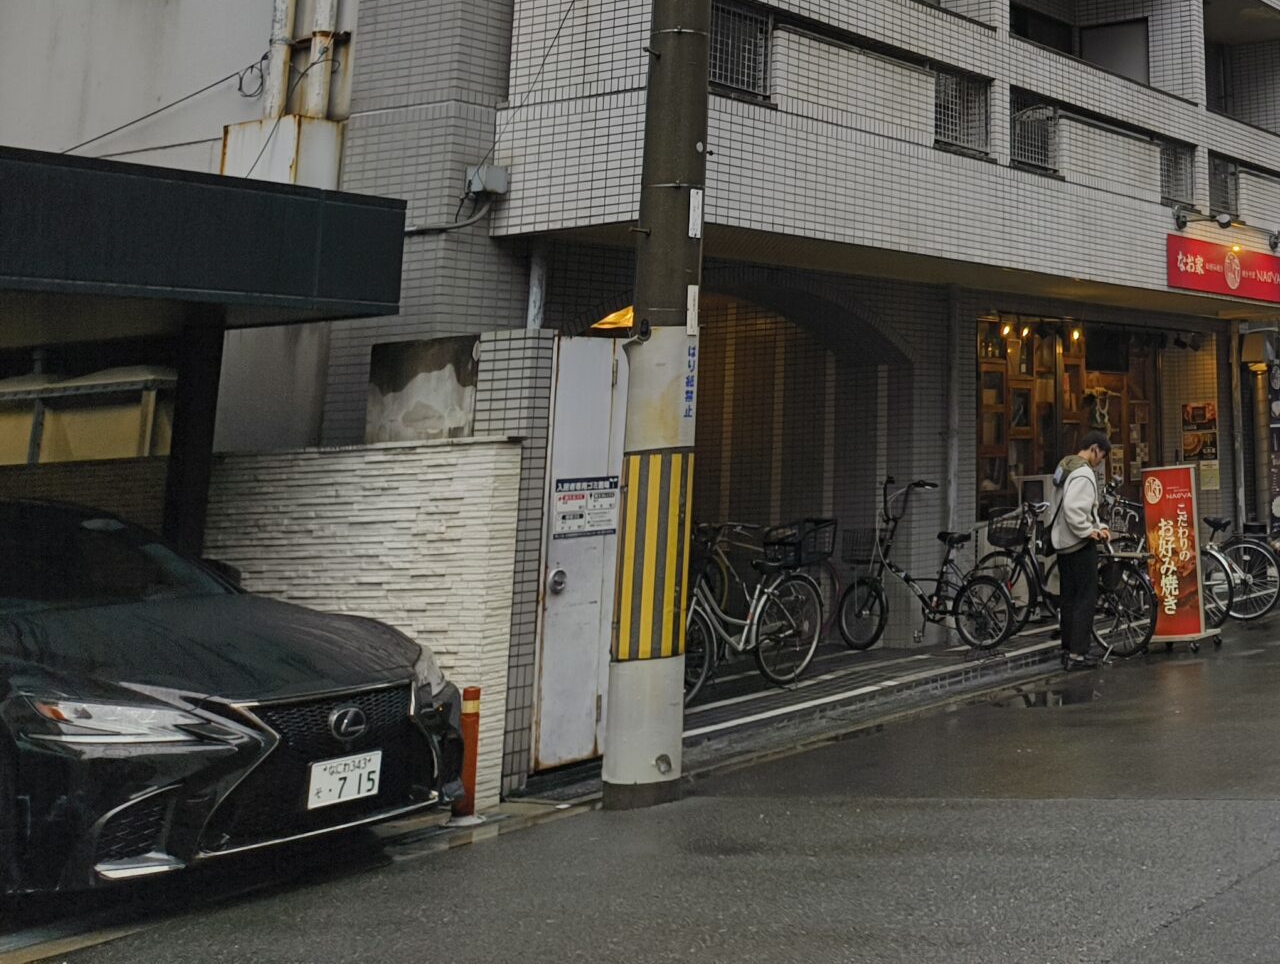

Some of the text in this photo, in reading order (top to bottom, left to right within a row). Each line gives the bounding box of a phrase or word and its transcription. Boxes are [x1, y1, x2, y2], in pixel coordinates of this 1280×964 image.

[684, 346, 697, 418] はり紙禁止
[1157, 518, 1180, 616] お好み焼き
[1176, 503, 1191, 562] こだわりの
